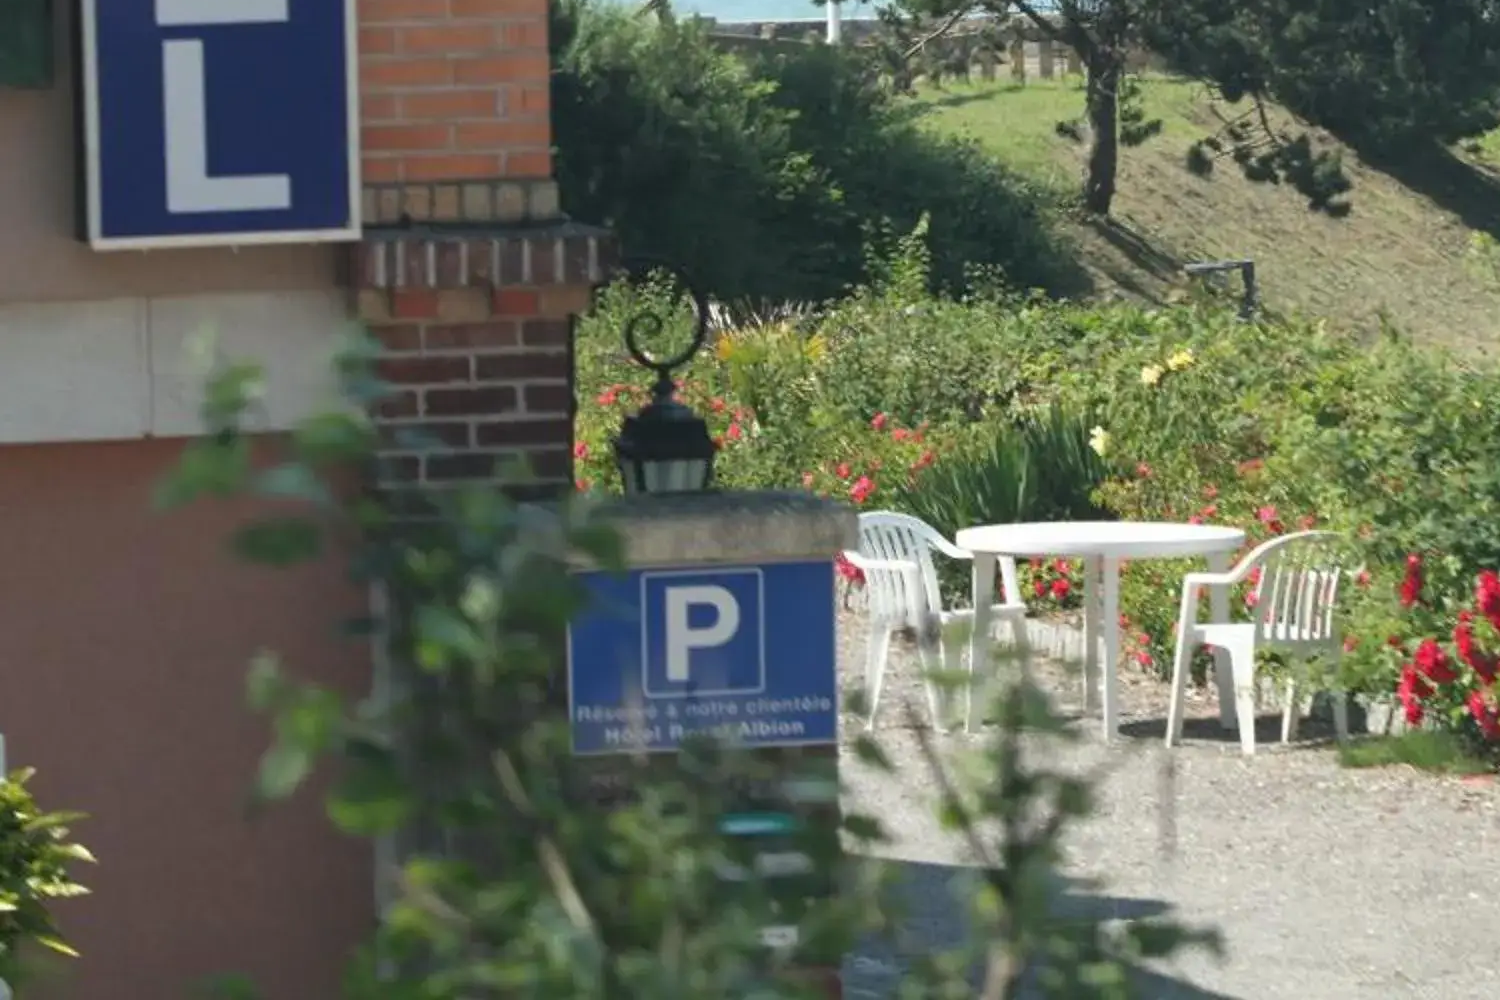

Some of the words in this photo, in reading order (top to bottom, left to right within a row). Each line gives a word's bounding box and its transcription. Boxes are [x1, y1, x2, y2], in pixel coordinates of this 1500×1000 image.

[665, 585, 740, 682] P
[685, 699, 738, 717] notre
[746, 694, 832, 714] clientèle
[739, 718, 806, 738] Albion
